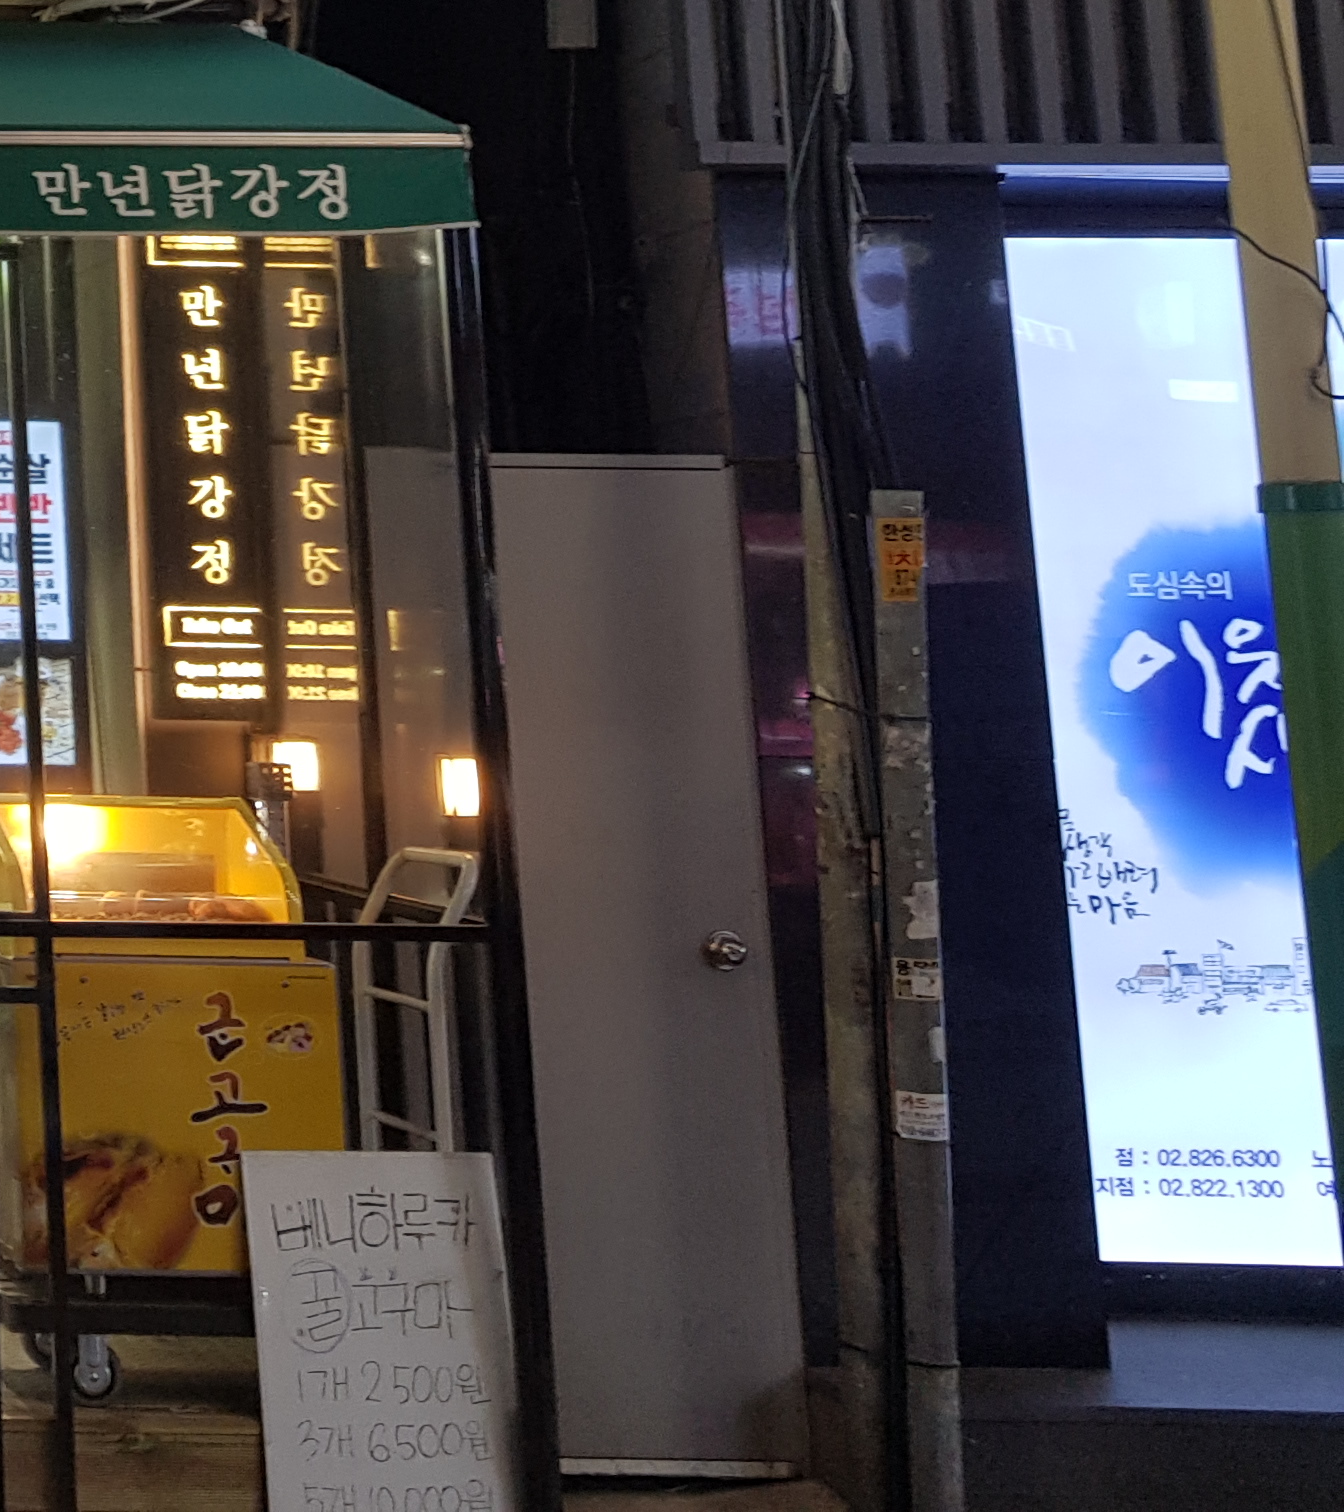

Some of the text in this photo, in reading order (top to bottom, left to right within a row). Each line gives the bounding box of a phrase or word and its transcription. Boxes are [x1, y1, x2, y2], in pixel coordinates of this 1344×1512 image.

[31, 162, 349, 221] 만년닭강정
[178, 285, 234, 586] 만년닭강정
[1126, 569, 1234, 601] 도심속의
[1157, 1148, 1281, 1168] 02.826.6300
[1095, 1176, 1136, 1198] 지점
[1158, 1178, 1286, 1199] 02.822.1300
